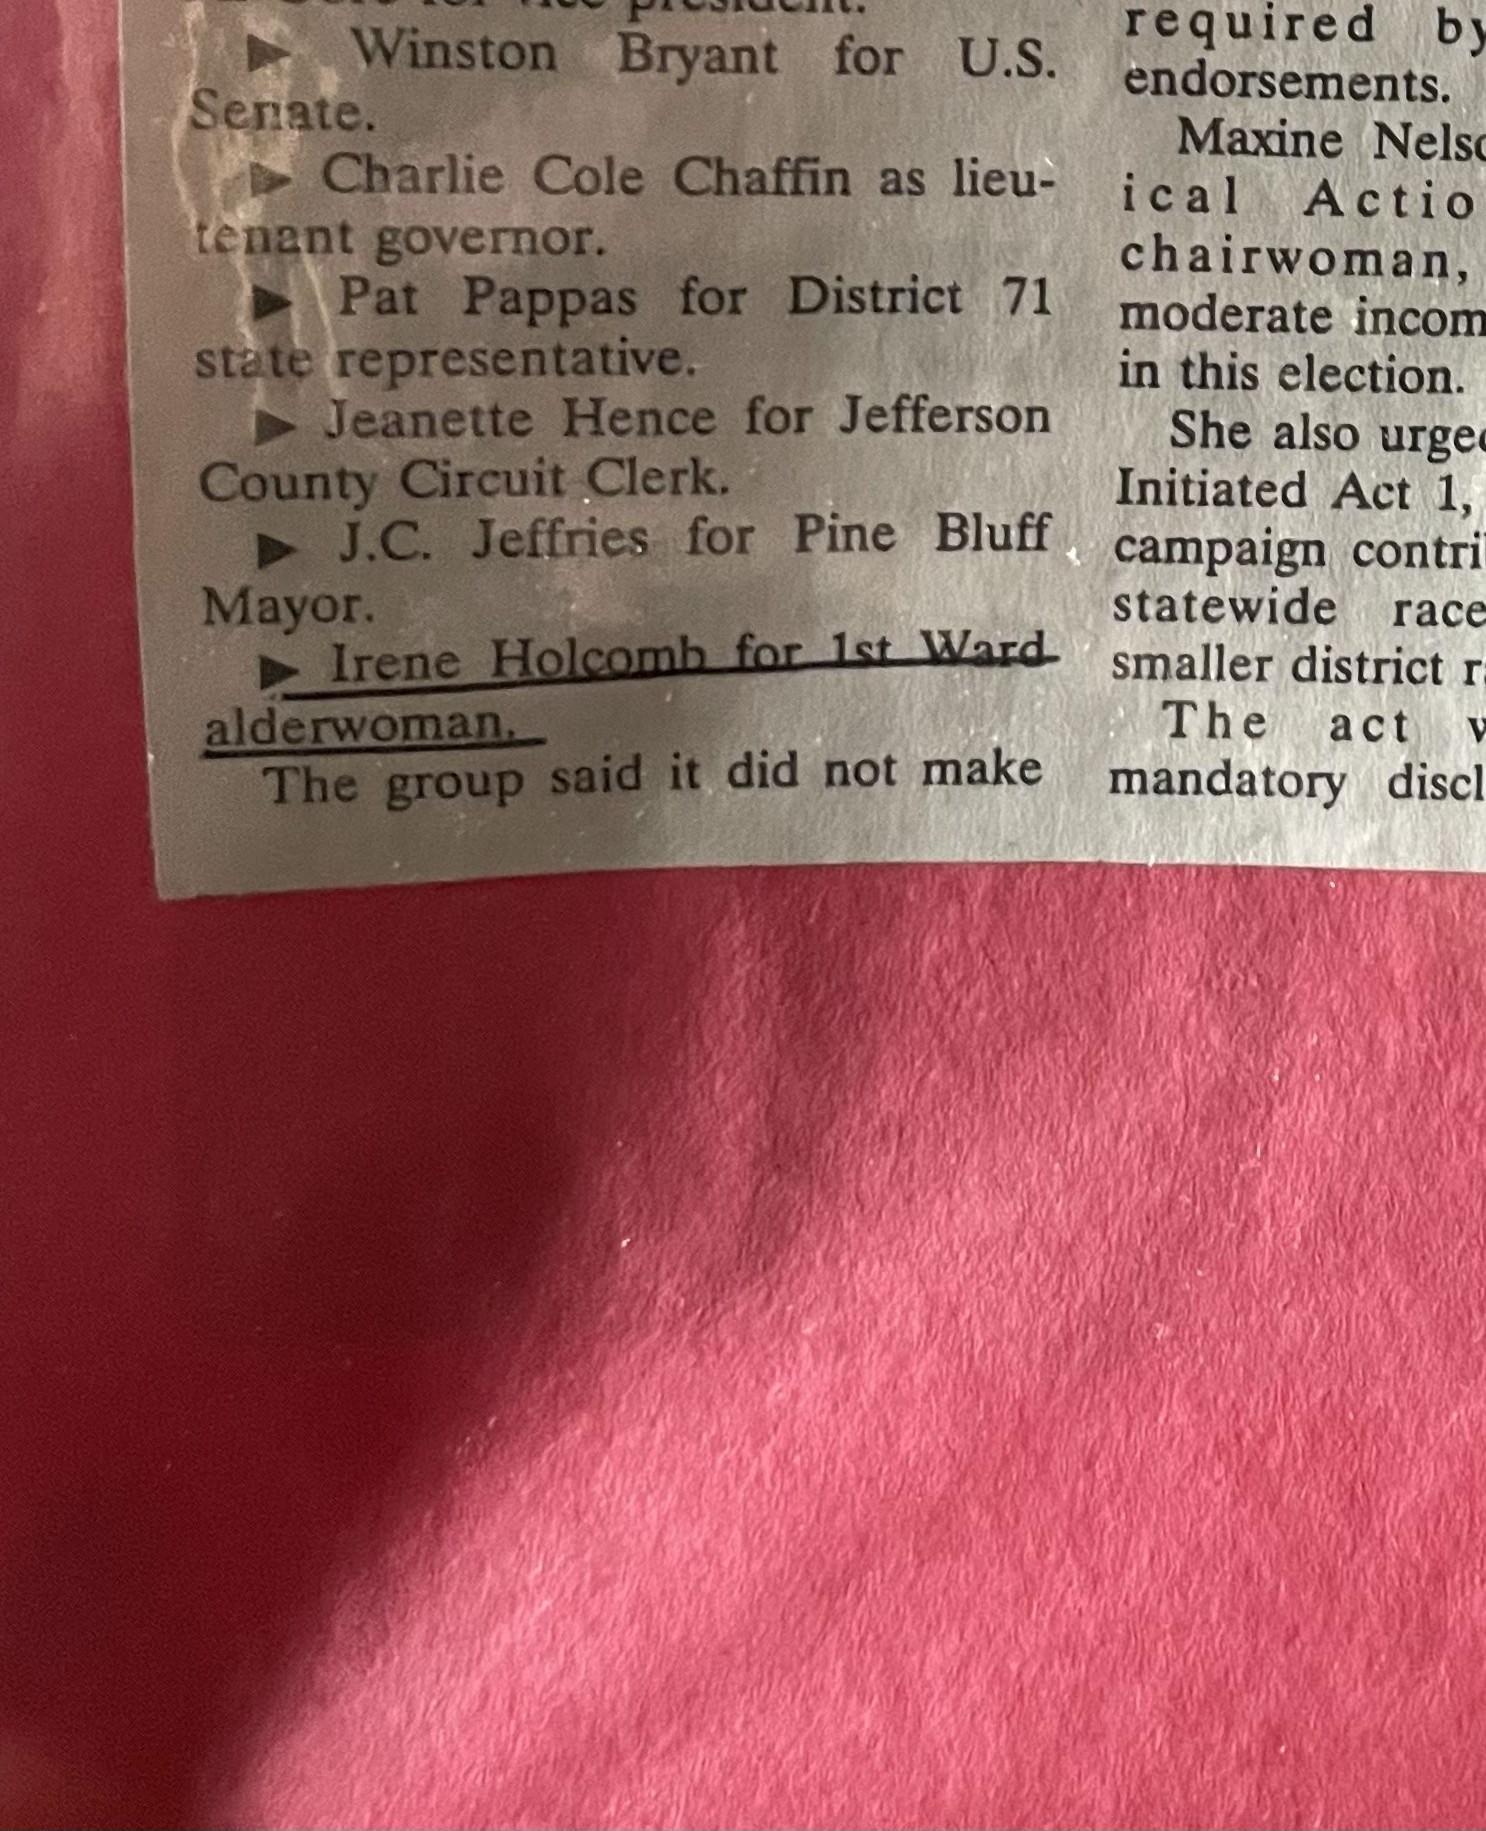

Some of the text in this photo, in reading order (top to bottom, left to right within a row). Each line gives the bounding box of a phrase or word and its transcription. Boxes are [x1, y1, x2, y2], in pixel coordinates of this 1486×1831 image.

[350, 25, 1056, 87] Winston Bryant for U.S.
[1123, 57, 1450, 104] endorsements.
[1178, 115, 1343, 160] Maxine
[337, 273, 1052, 329] Pat Pappas for District 71
[1119, 291, 1333, 335] moderate
[1118, 347, 1464, 395] in this election.
[324, 392, 1051, 440] Jeanette Hence for Jefferson
[1170, 408, 1252, 451] She
[1273, 411, 1360, 453] also
[1109, 757, 1348, 812] mandatory
